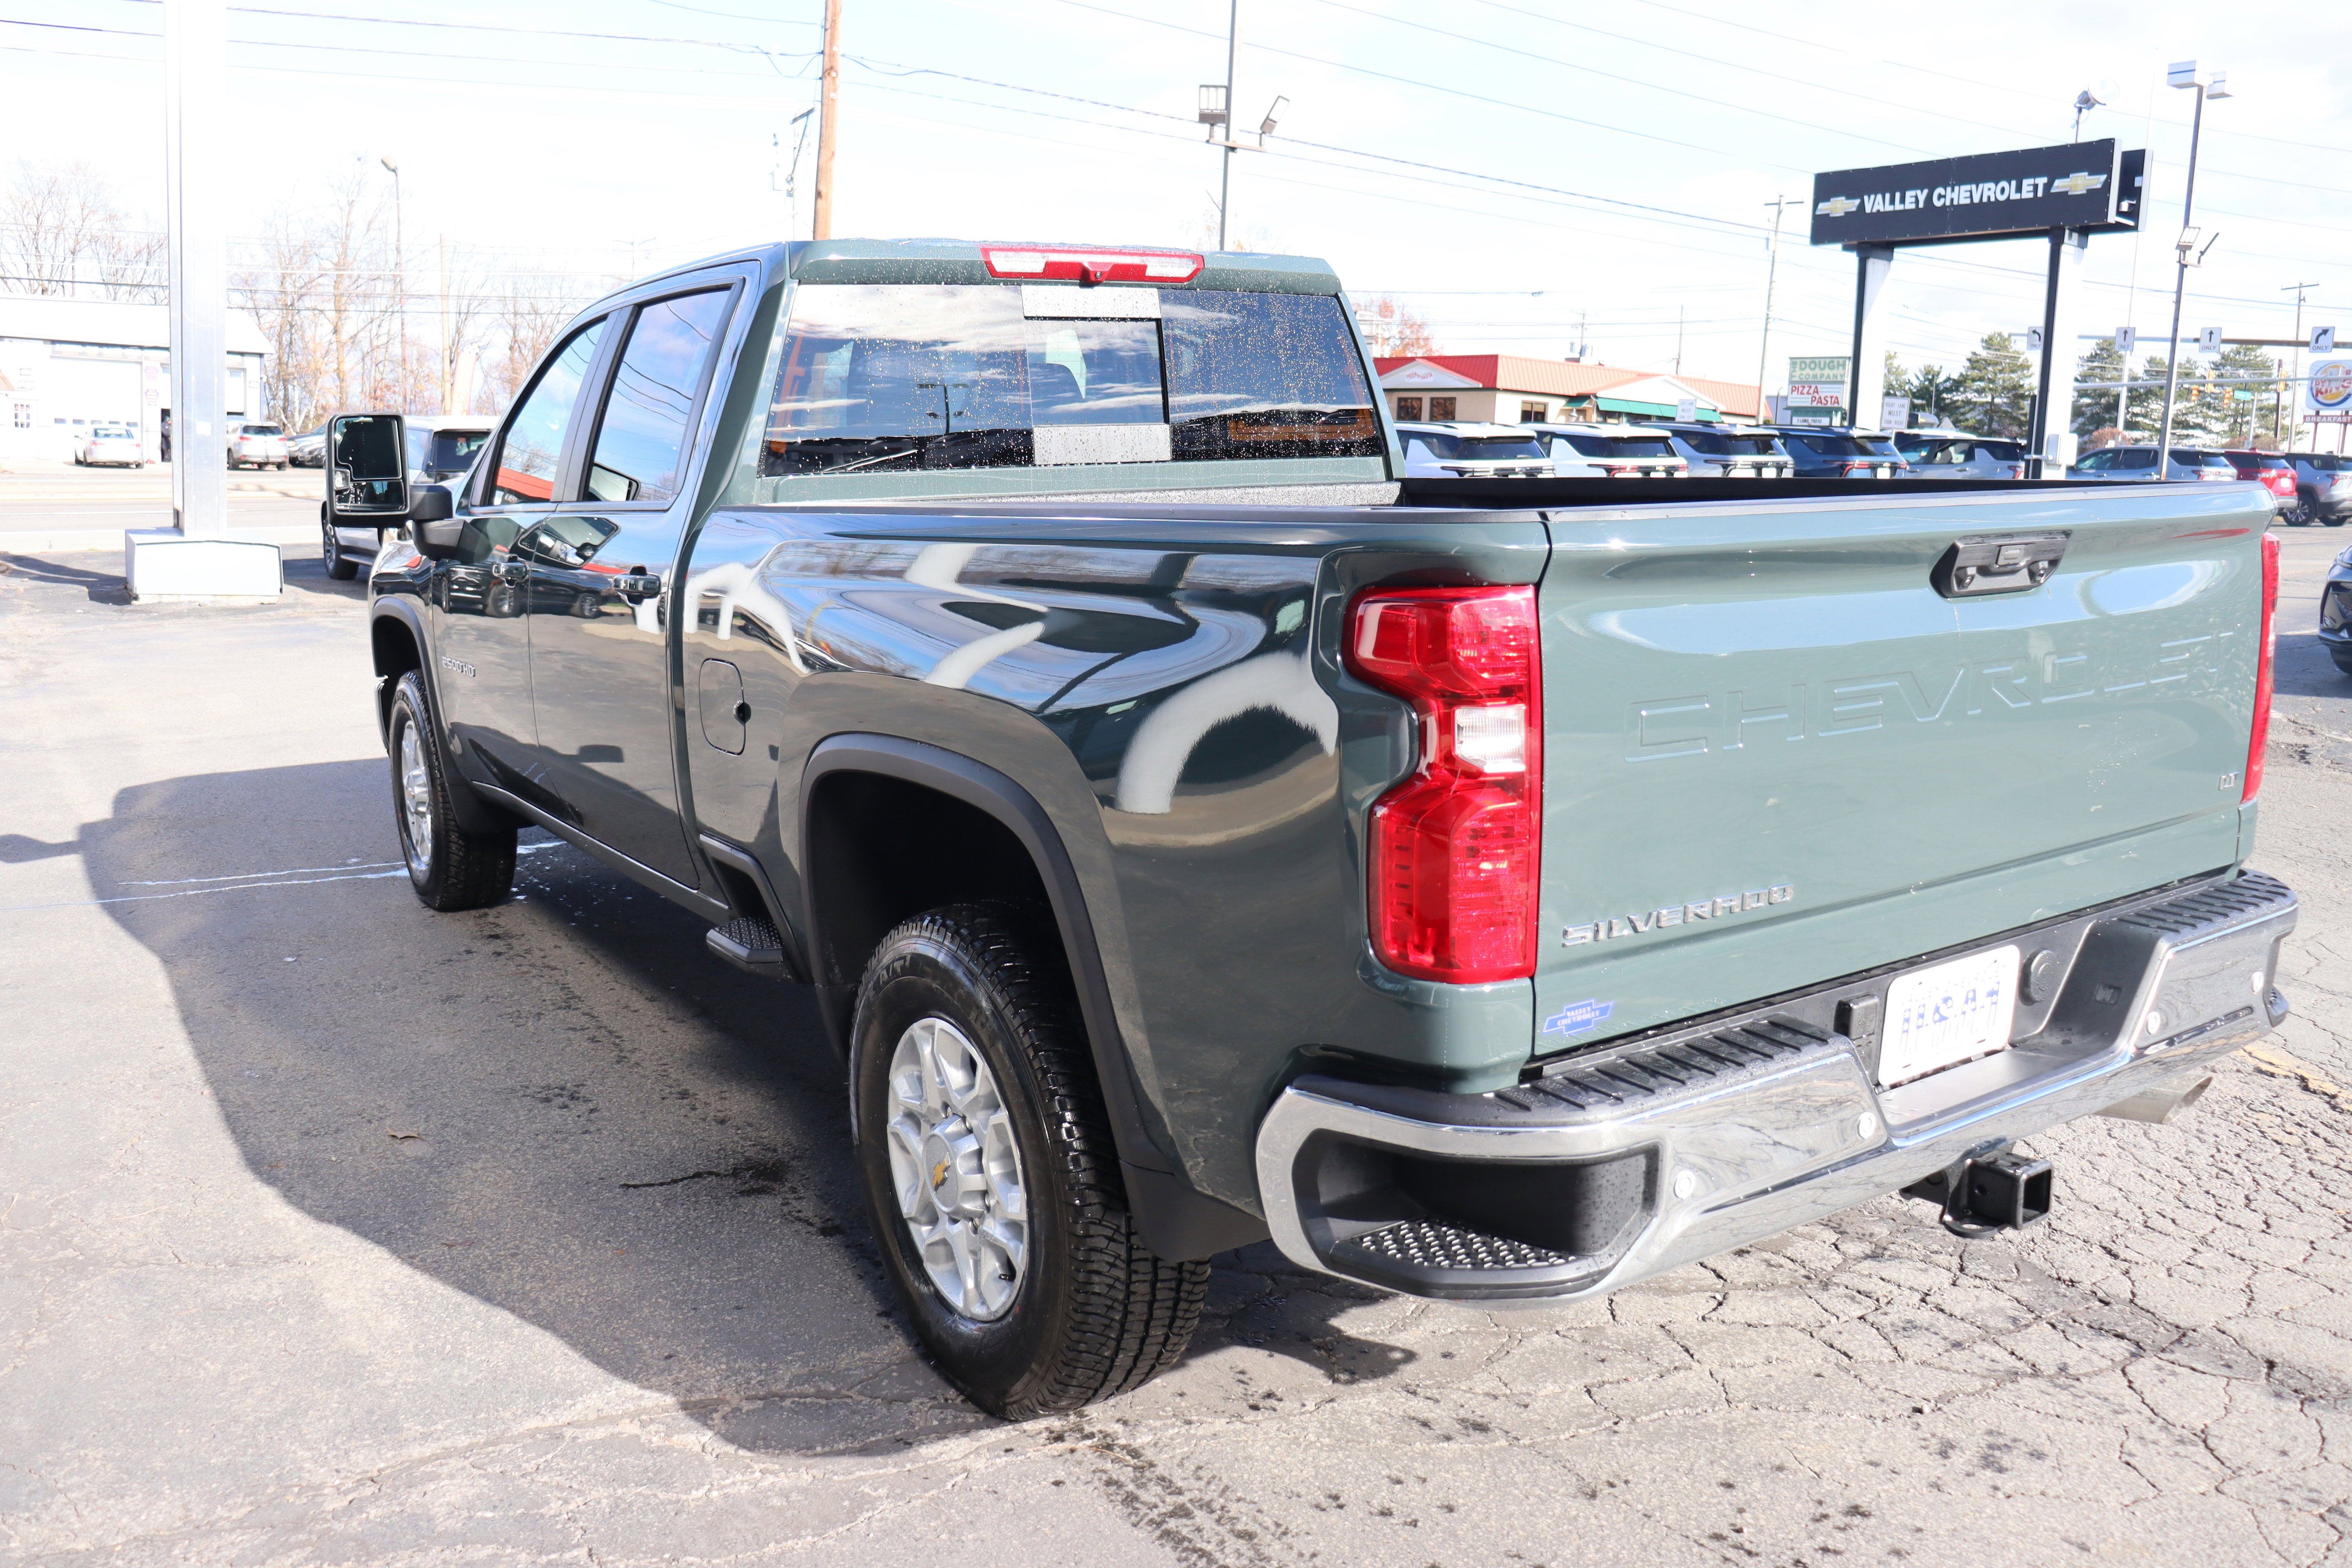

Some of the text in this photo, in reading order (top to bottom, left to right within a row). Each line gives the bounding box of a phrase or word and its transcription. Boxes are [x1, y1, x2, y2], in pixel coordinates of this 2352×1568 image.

[1864, 177, 2047, 213] VALLEY CHEVROLET
[1800, 360, 1846, 371] DOUGH
[1791, 385, 1819, 395] PIZZA
[1811, 396, 1840, 405] PASTA
[1624, 631, 2234, 763] CHEVROLET
[1561, 882, 1793, 948] SILVERADO
[1557, 1009, 1600, 1026] CHEVROLET
[1566, 1006, 1591, 1017] VALLEY
